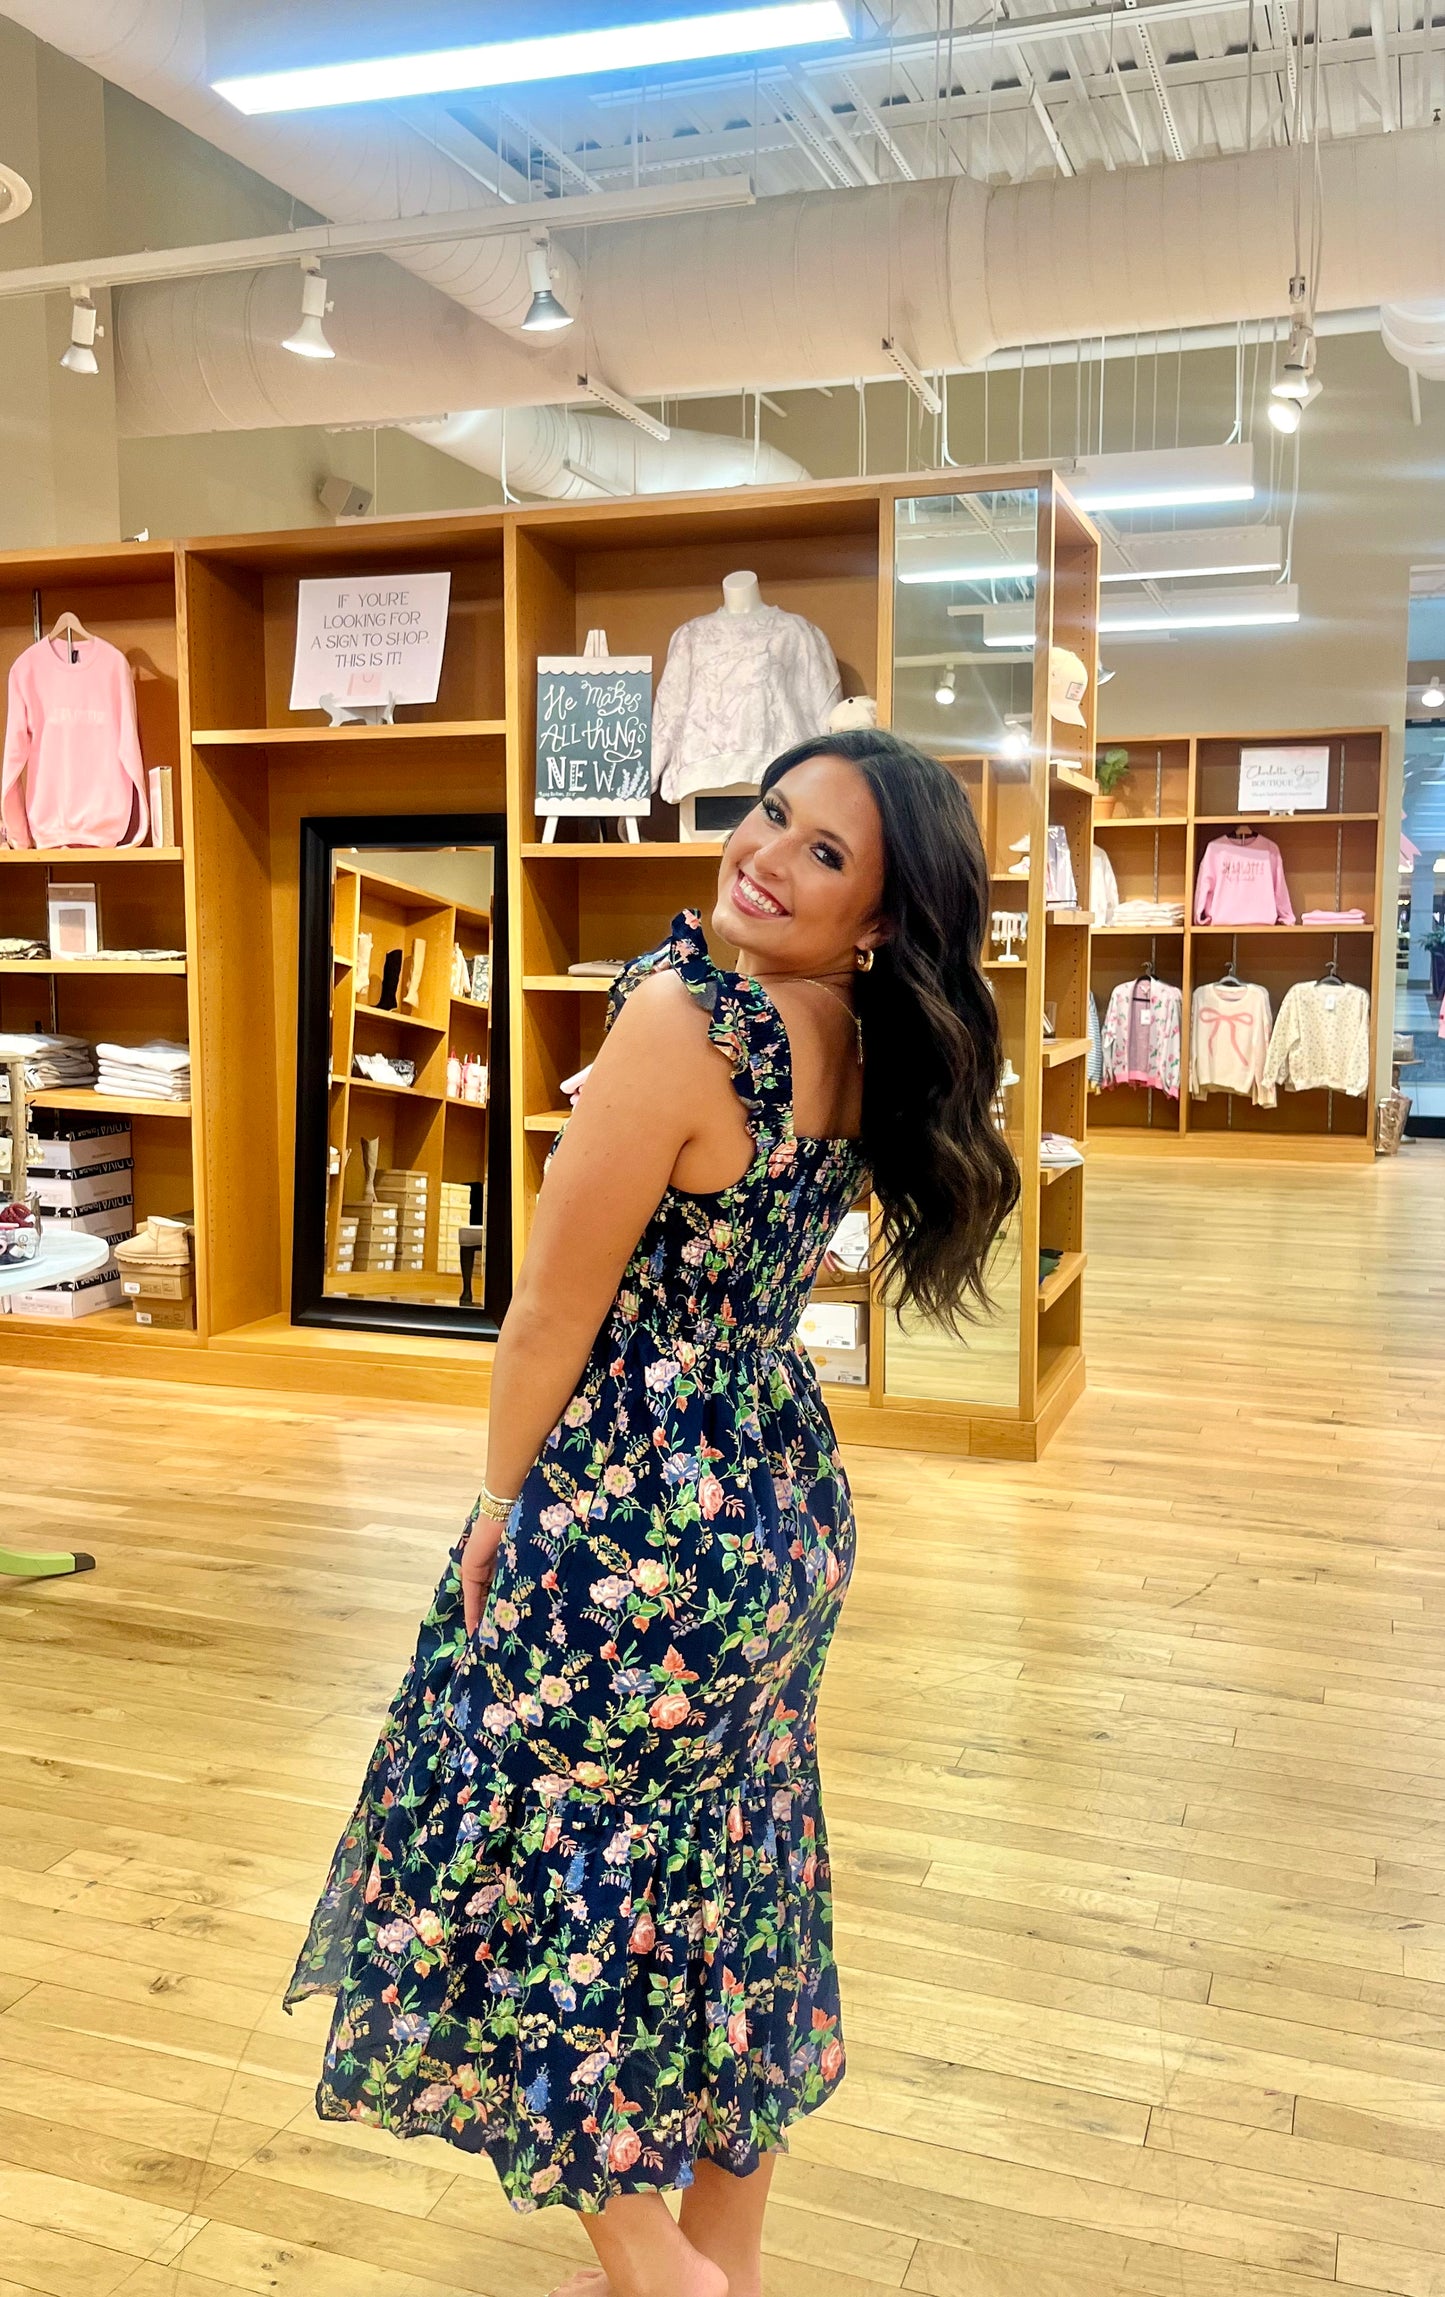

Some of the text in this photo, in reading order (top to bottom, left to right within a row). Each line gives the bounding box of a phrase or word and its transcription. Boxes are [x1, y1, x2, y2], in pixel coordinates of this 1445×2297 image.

[337, 594, 350, 609] IF
[323, 611, 421, 630] LOOKING FOR
[311, 636, 322, 650] A
[326, 634, 359, 649] SIGN
[362, 632, 383, 647] TO
[335, 651, 403, 669] THIS IS IT!
[543, 679, 642, 722] He makes
[539, 723, 582, 753] ALL
